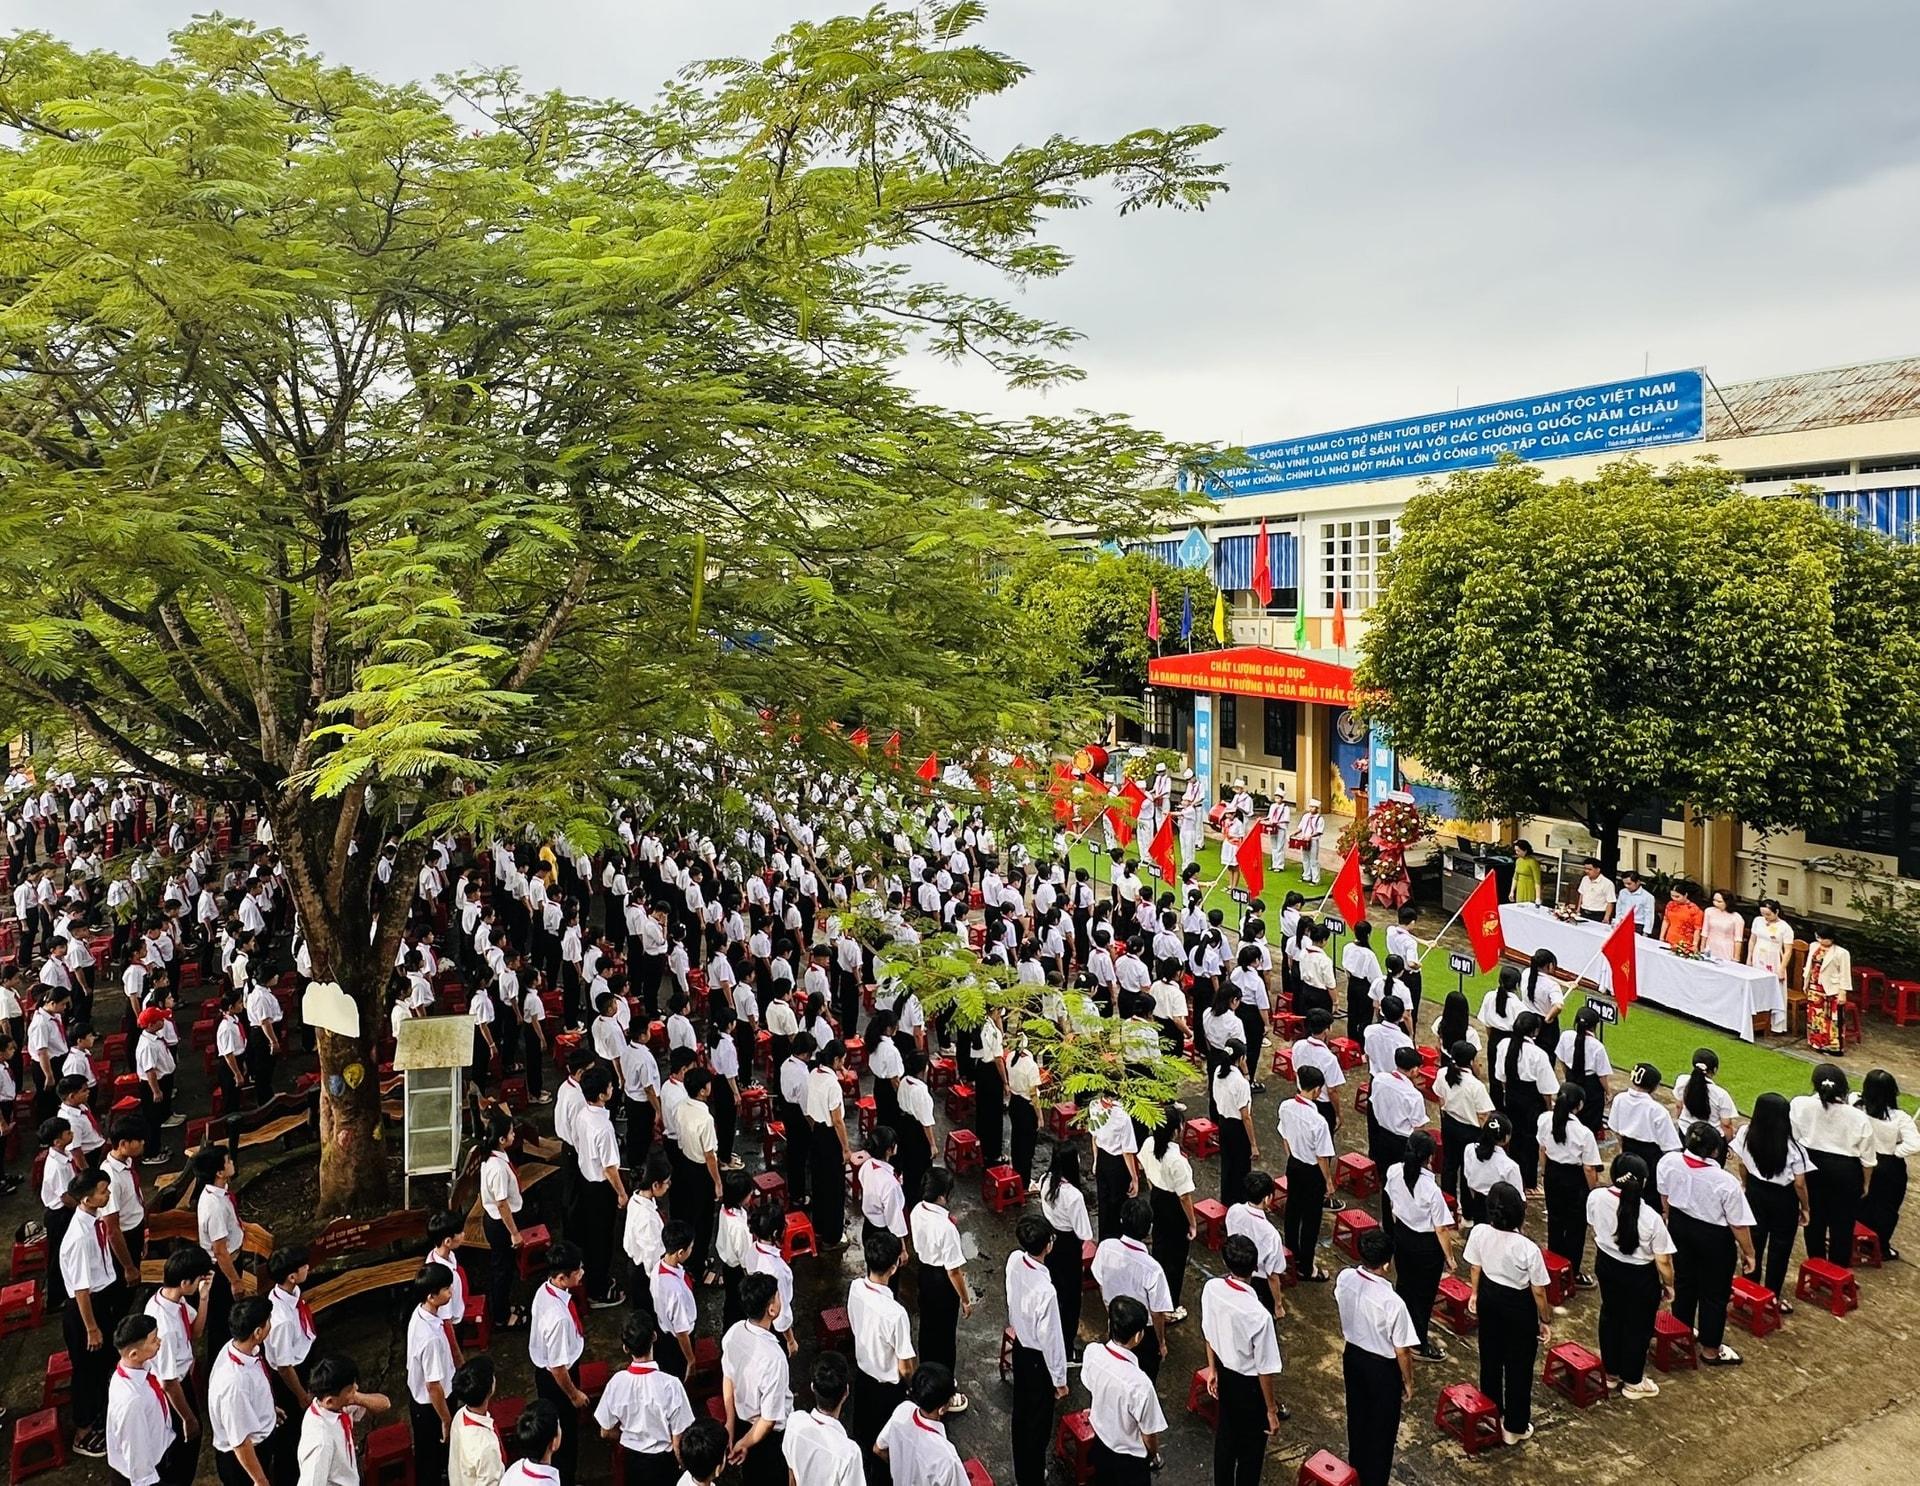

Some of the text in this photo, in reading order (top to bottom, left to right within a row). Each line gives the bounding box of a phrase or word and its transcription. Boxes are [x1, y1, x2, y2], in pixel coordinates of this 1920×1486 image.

[1257, 449, 1284, 460] SÔNG
[1285, 445, 1306, 457] VIỆT
[1307, 442, 1328, 452] NAM
[1330, 437, 1345, 448] CÓ
[1348, 433, 1368, 446] TRỞ
[1370, 430, 1392, 442] NÊN
[1395, 425, 1420, 438] TƯƠI
[1423, 421, 1447, 434] ĐẸP
[1450, 416, 1474, 429] HAY
[1477, 408, 1528, 425] KHÔNG,
[1532, 401, 1561, 416] DÂN
[1565, 395, 1596, 410] TỘC
[1601, 388, 1635, 404] VIỆT
[1640, 381, 1676, 398] NAM
[1286, 457, 1309, 468] VINH
[1311, 451, 1349, 465] QUANG
[1351, 444, 1367, 459] ĐỂ
[1369, 442, 1400, 456] SÁNH
[1403, 439, 1423, 451] VAI
[1425, 435, 1447, 449] VỚI
[1450, 429, 1478, 445] CÁC
[1482, 422, 1533, 440] CƯỜNG
[1537, 411, 1583, 430] QUỐC
[1587, 407, 1623, 424] NĂM
[1629, 398, 1679, 417] CHÂU
[1235, 478, 1251, 488] HAY
[1285, 469, 1313, 481] CHÍNH
[1314, 466, 1327, 477] LÀ
[1329, 462, 1350, 475] NHỜ
[1352, 460, 1374, 473] MỘT
[1375, 454, 1404, 469] PHẦN
[1407, 452, 1429, 465] LỚN
[1432, 449, 1441, 461] Ở
[1443, 446, 1478, 460] CÔNG
[1481, 442, 1508, 455] HỌC
[1511, 437, 1537, 452] TẬP
[1540, 431, 1570, 447] CỦA
[1573, 427, 1604, 441] CÁC
[1150, 670, 1160, 681] LÀ
[1160, 671, 1181, 682] DANH
[1193, 672, 1209, 686] CỦA
[1210, 675, 1227, 688] NHÀ
[1229, 674, 1263, 691] TRƯỜNG
[1265, 680, 1276, 694] VÀ
[1277, 680, 1297, 696] CỦA
[1211, 658, 1306, 681] CHẤT LƯỢNG GIÁO DỤC
